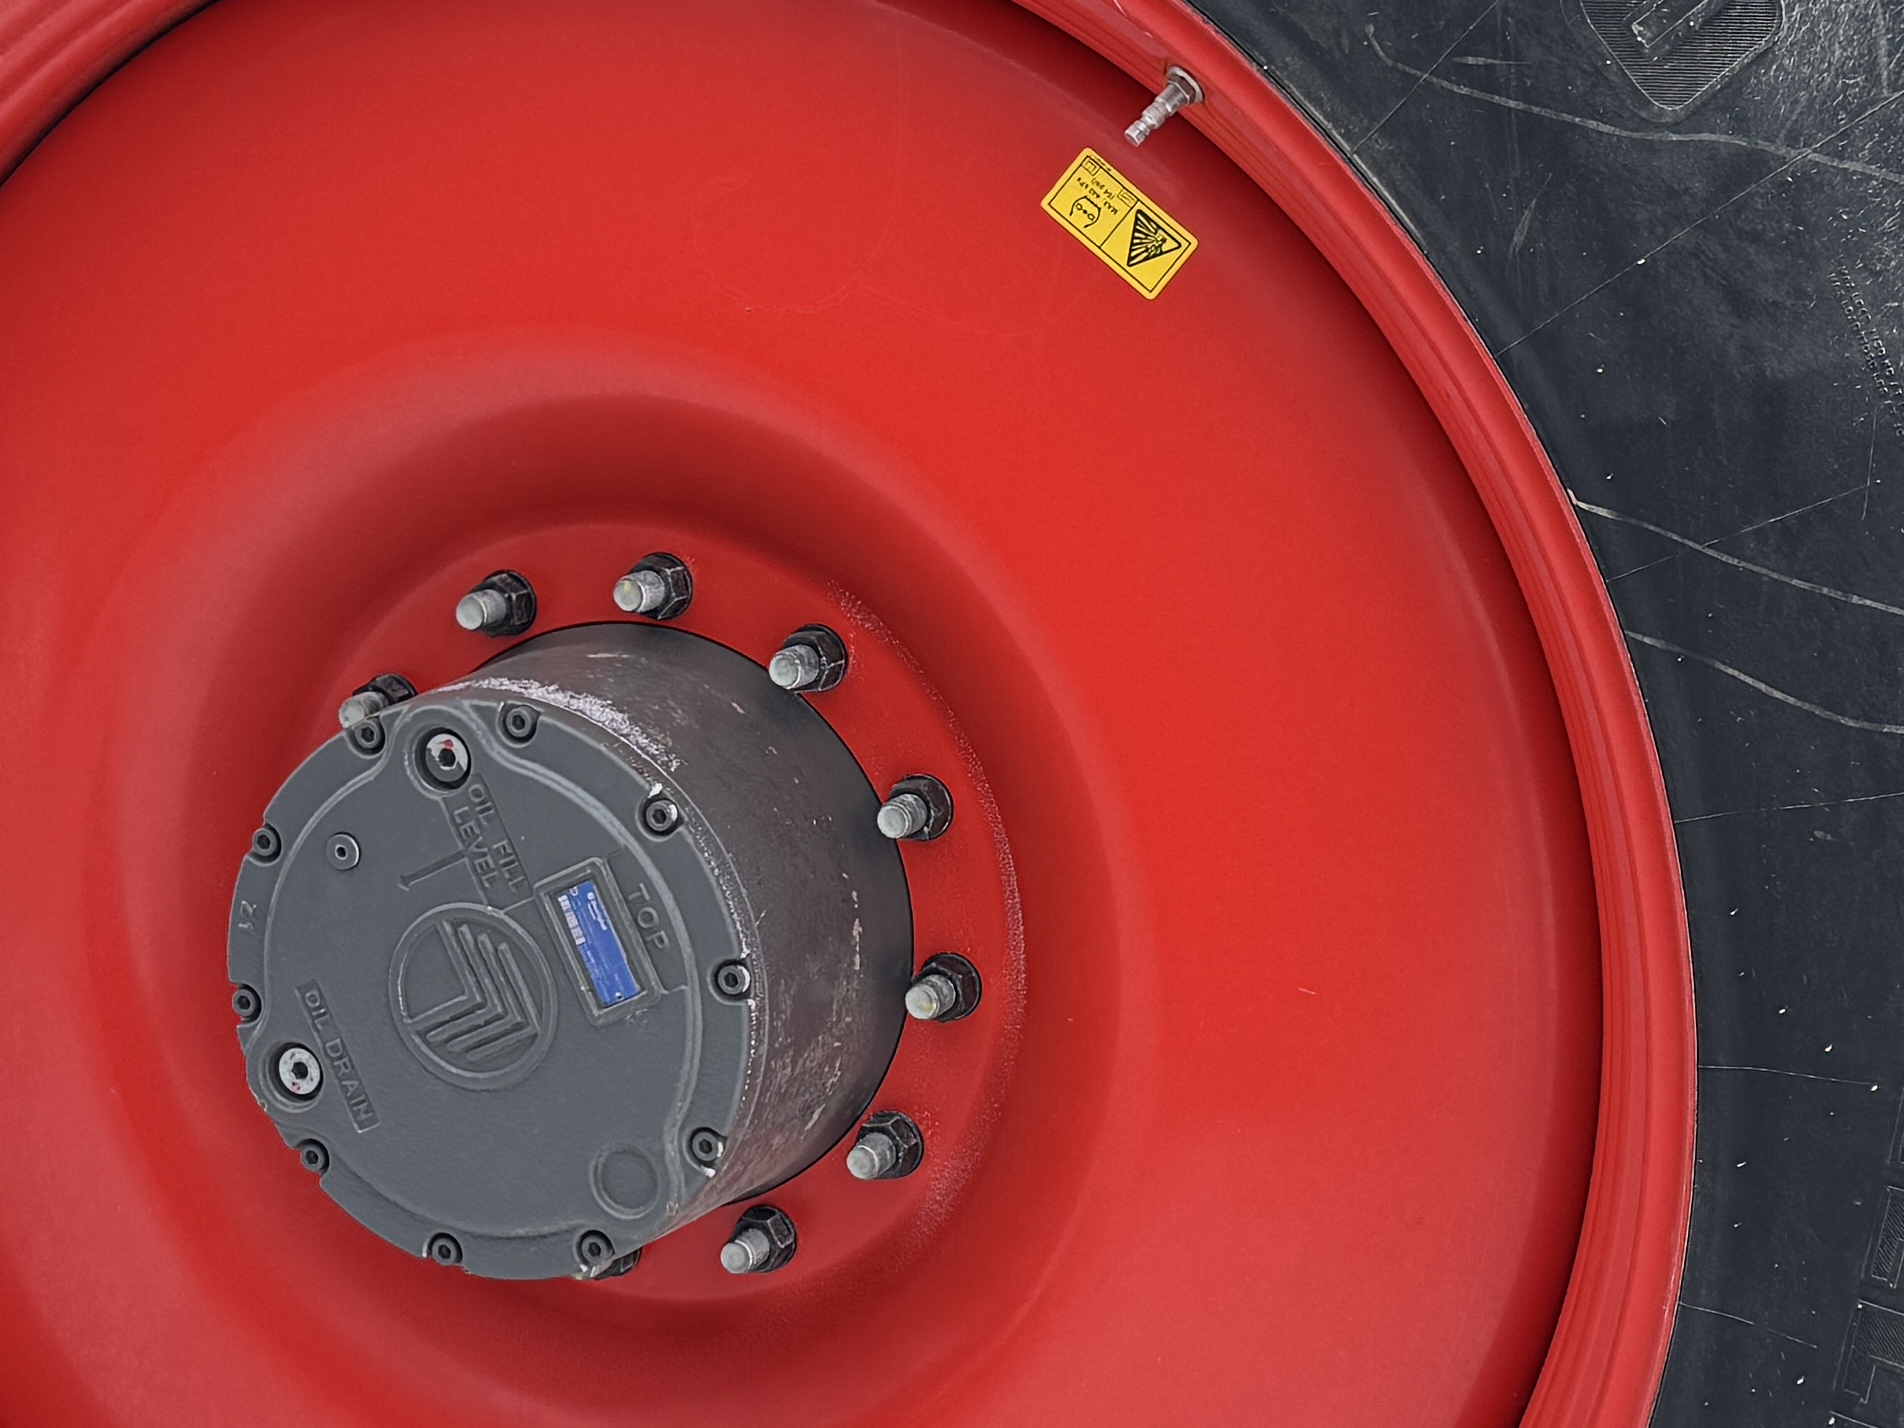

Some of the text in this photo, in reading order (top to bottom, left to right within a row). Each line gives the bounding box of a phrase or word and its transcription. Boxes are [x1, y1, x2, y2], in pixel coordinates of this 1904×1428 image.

[452, 805, 495, 890] LEVEL
[467, 782, 527, 893] OIL FILL
[627, 882, 671, 952] TOP
[303, 990, 374, 1124] OIL DRAIN
